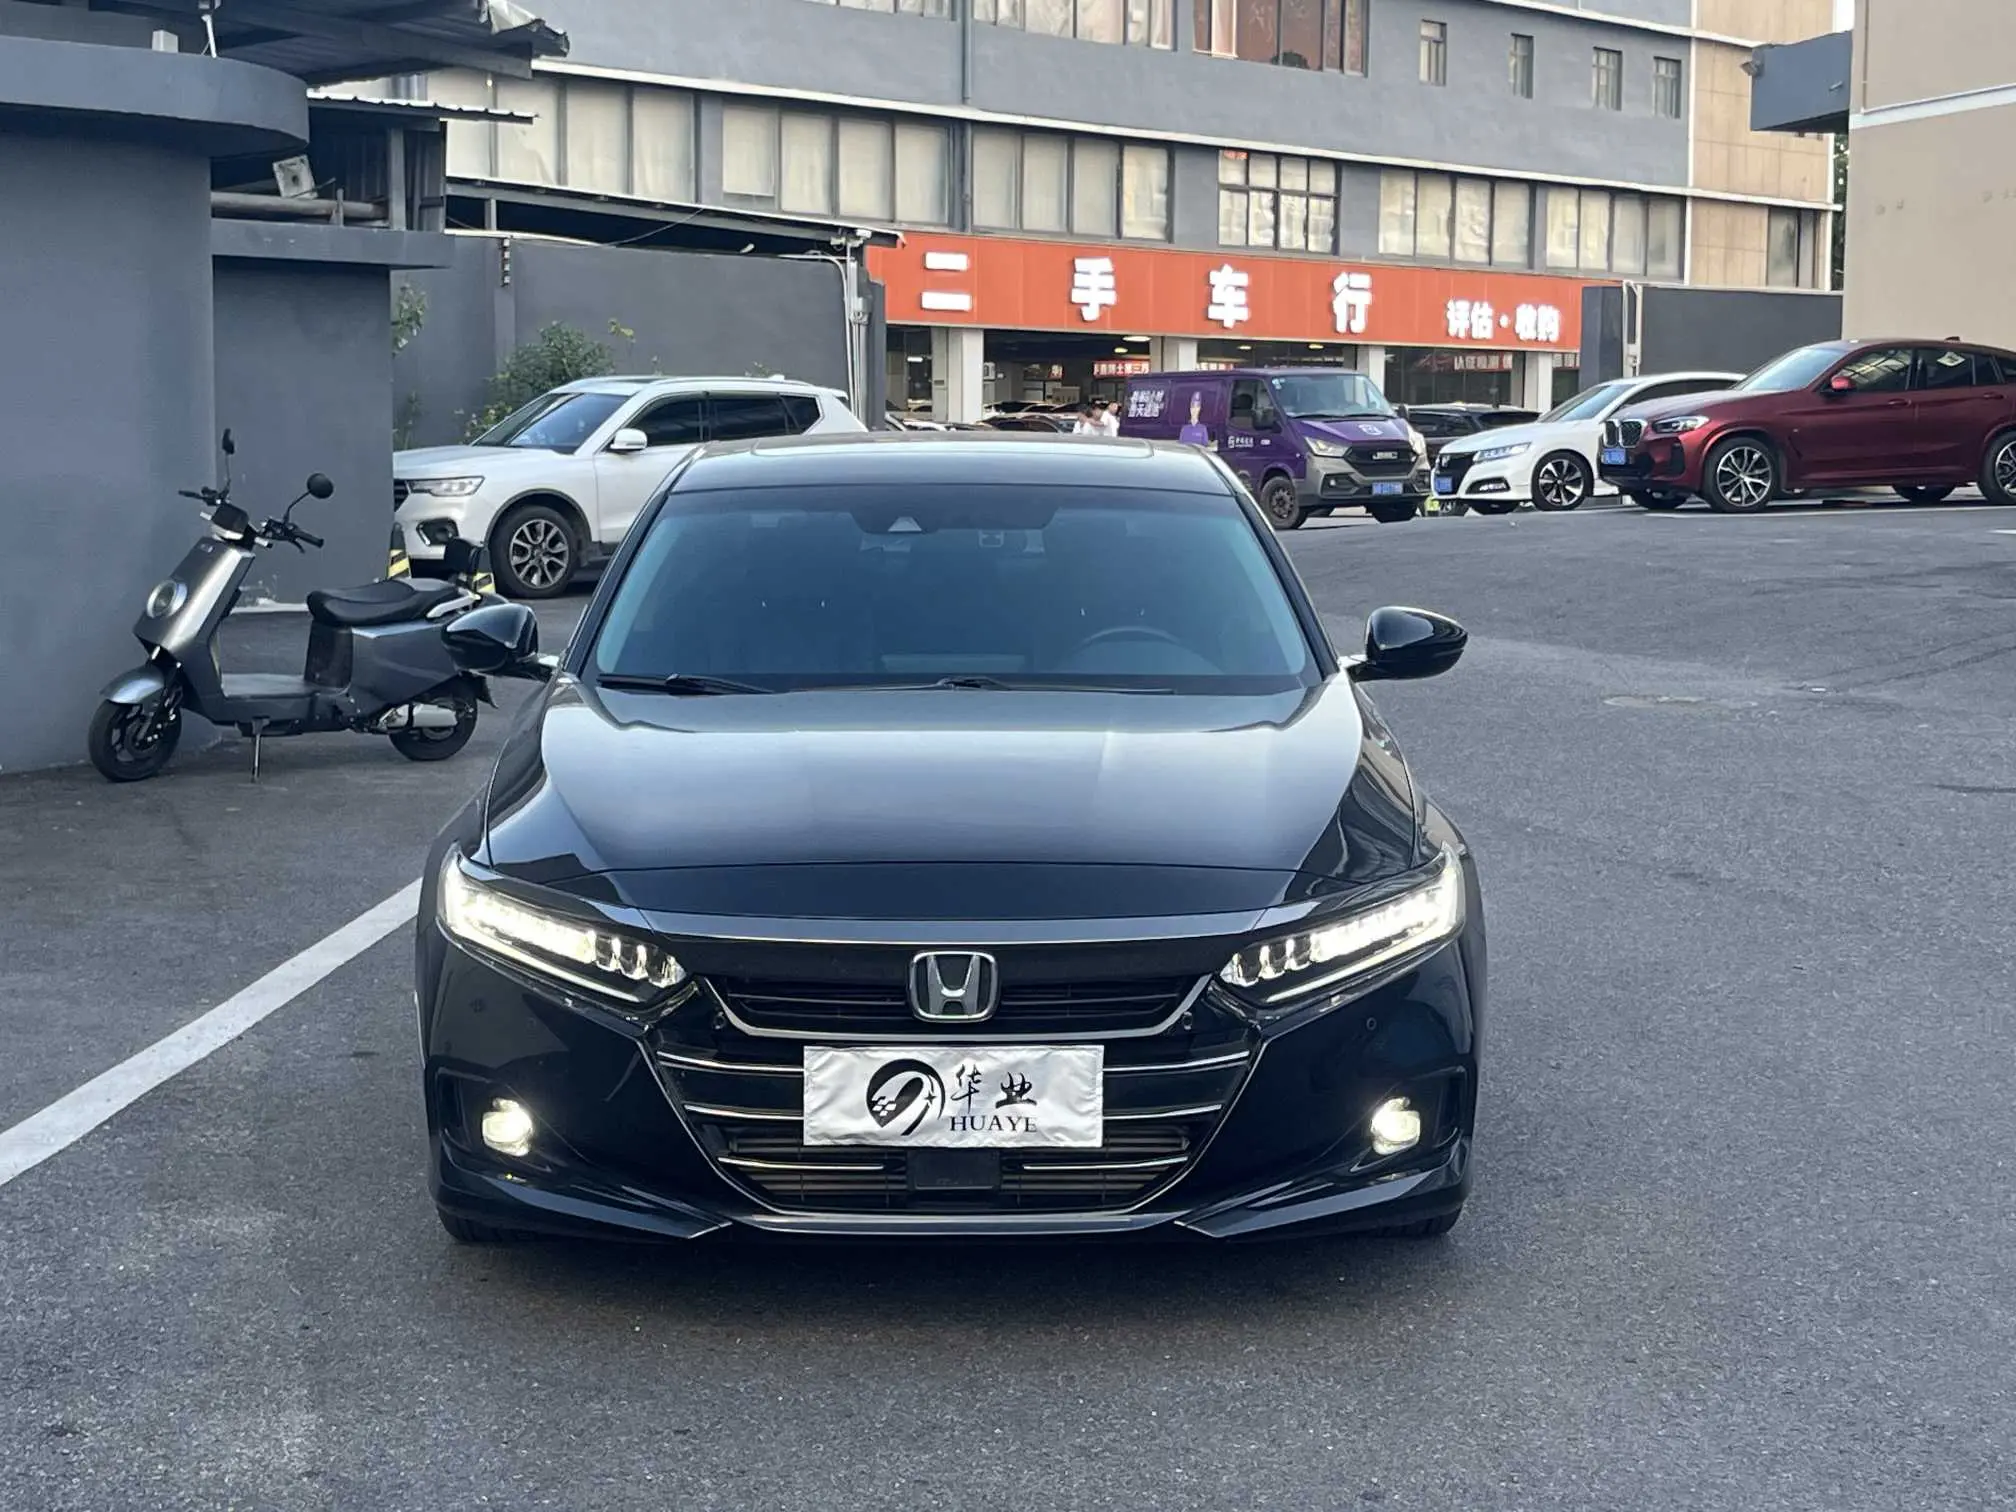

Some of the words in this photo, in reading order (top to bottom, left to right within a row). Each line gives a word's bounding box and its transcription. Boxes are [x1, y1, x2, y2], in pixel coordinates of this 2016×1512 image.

[921, 251, 1373, 335] 二手车行
[950, 1064, 1037, 1113] 华业
[950, 1115, 1038, 1132] HUAYE
